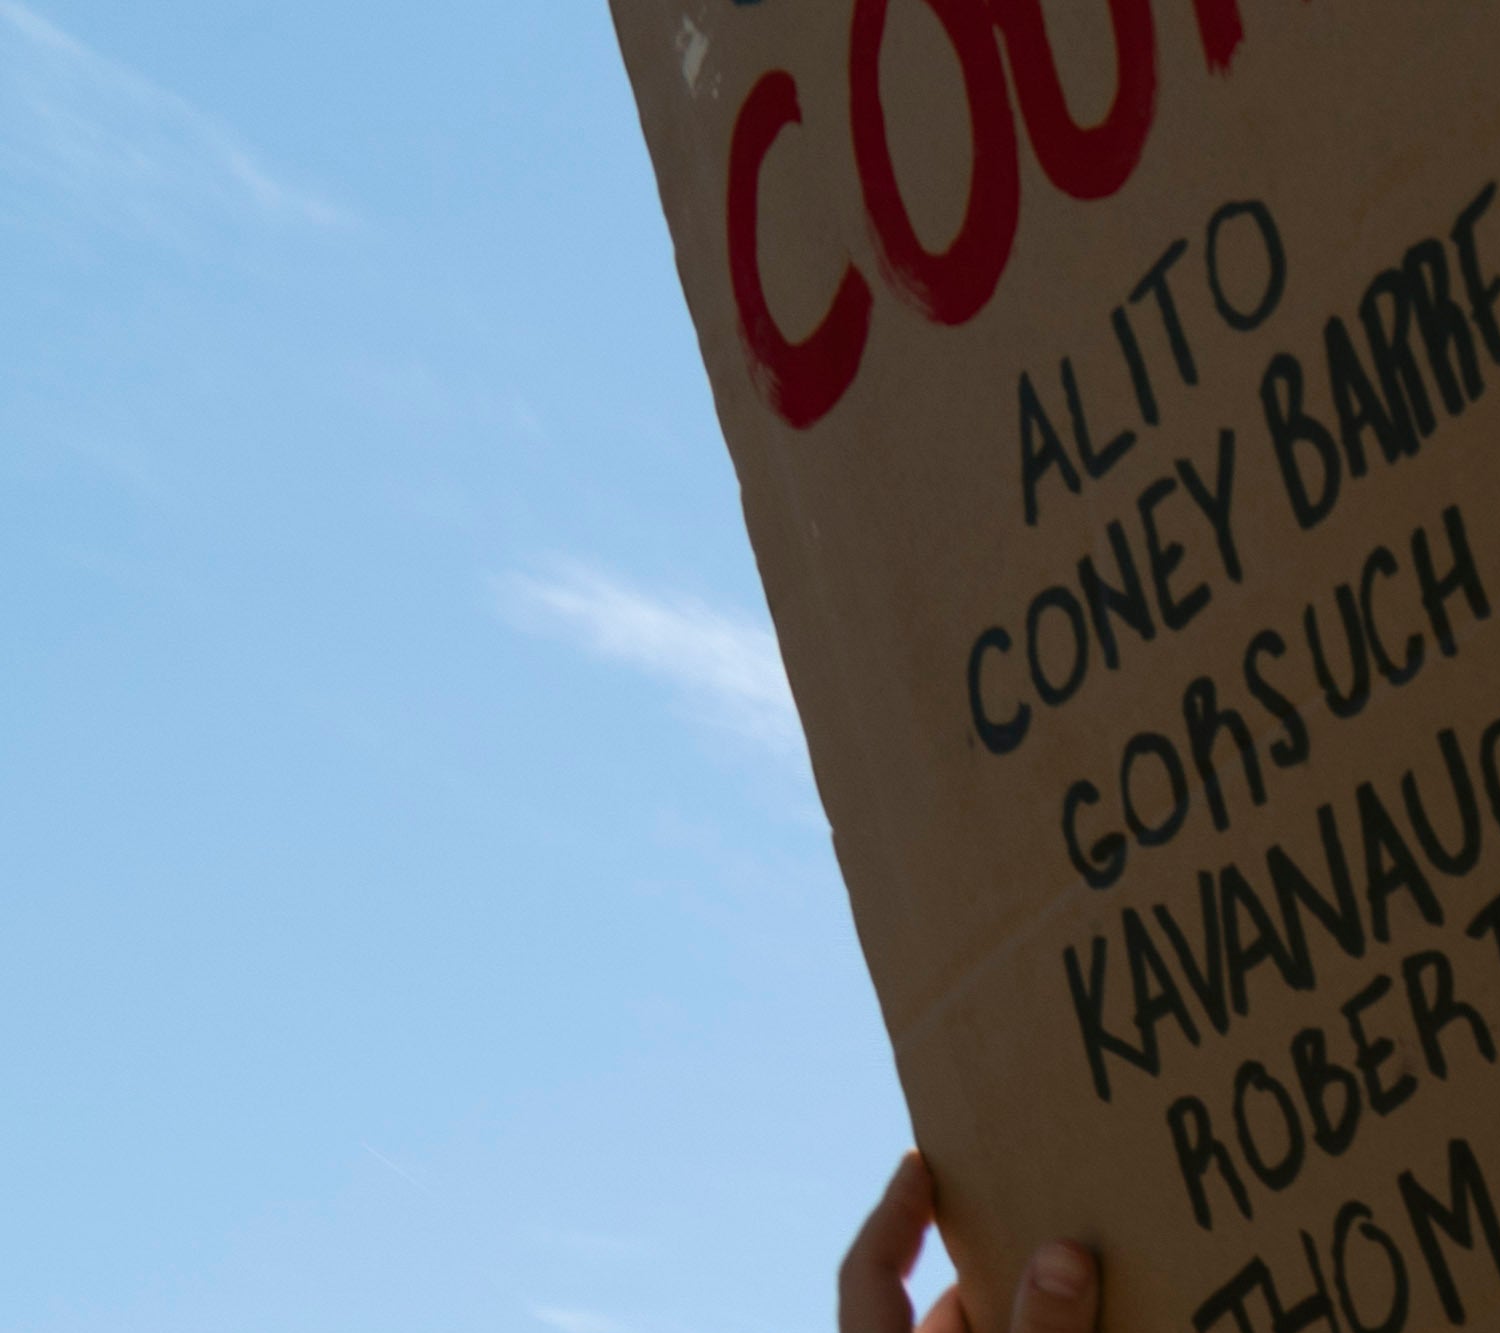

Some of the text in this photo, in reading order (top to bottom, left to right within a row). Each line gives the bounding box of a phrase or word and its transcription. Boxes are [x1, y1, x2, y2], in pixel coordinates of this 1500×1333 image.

[1021, 200, 1287, 525] ALITO
[968, 432, 1244, 753] CONEY
[1061, 505, 1491, 887] GORSUCH
